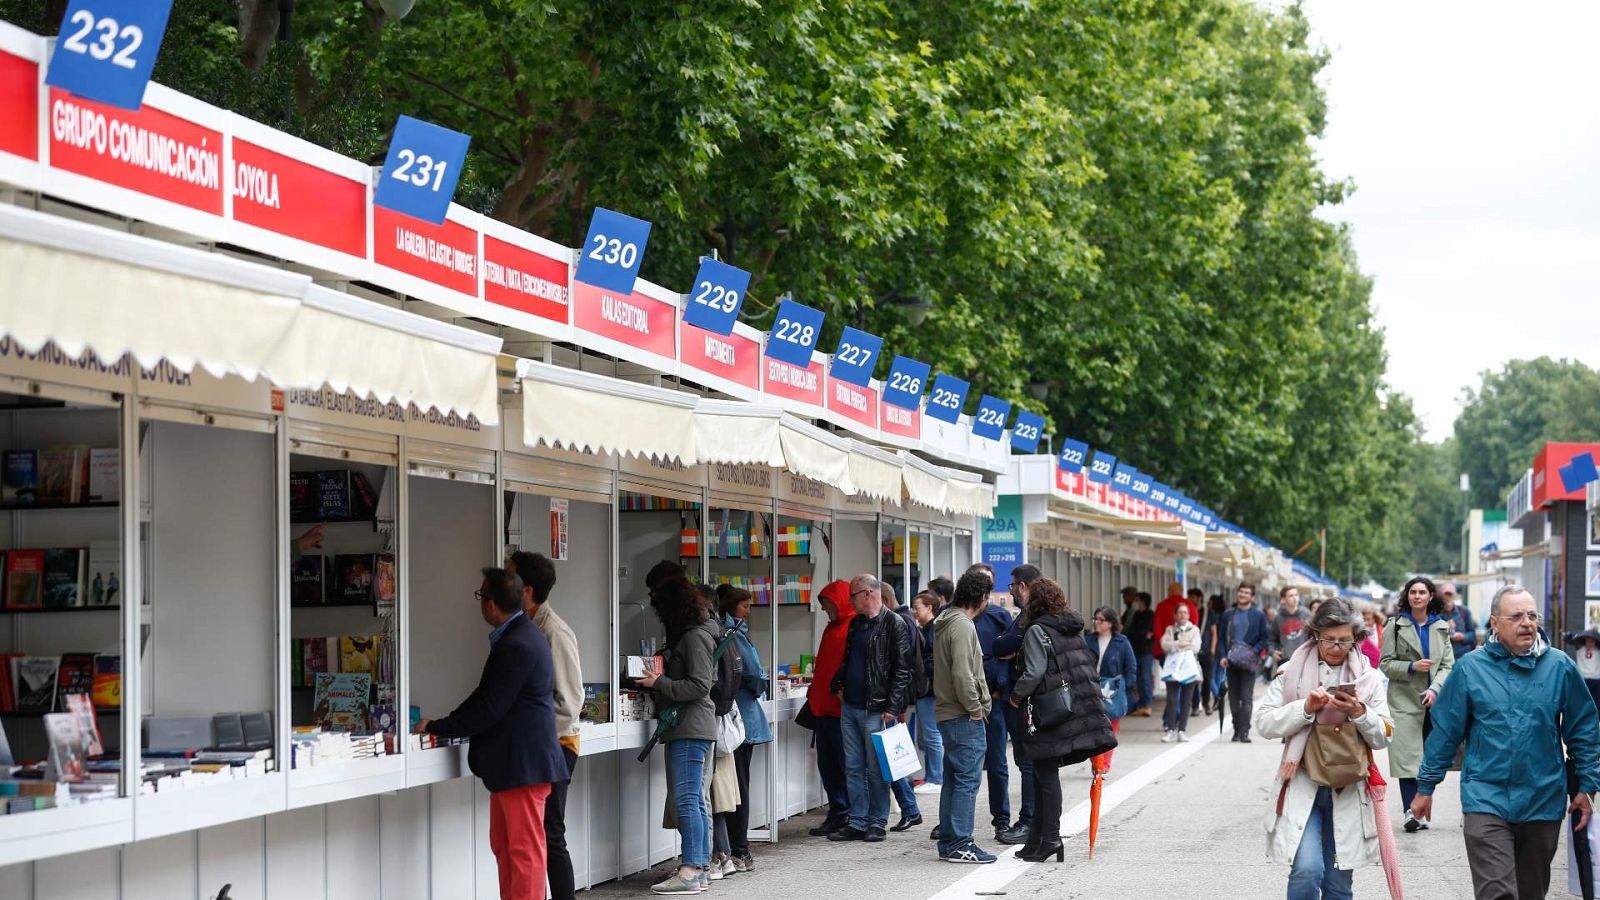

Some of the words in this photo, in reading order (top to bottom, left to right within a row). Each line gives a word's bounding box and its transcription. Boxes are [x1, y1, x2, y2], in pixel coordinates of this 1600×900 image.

[63, 9, 144, 70] 232
[53, 99, 107, 155] GRUPO
[109, 119, 219, 190] COMUNICACIÓN
[232, 159, 281, 209] LOYOLA
[391, 149, 447, 192] 231
[396, 226, 405, 250] LA
[430, 239, 452, 268] ELASTIC
[588, 234, 637, 269] 230
[695, 281, 738, 313] 229
[775, 318, 814, 347] 228
[837, 342, 872, 367] 227
[890, 372, 921, 395] 226
[932, 388, 960, 409] 225
[978, 407, 1004, 428] 224
[1015, 422, 1038, 440] 223
[1062, 448, 1083, 465] 222
[1091, 460, 1110, 475] 222
[1114, 471, 1131, 486] 221
[1131, 480, 1149, 494] 220
[986, 518, 1017, 532] 29A
